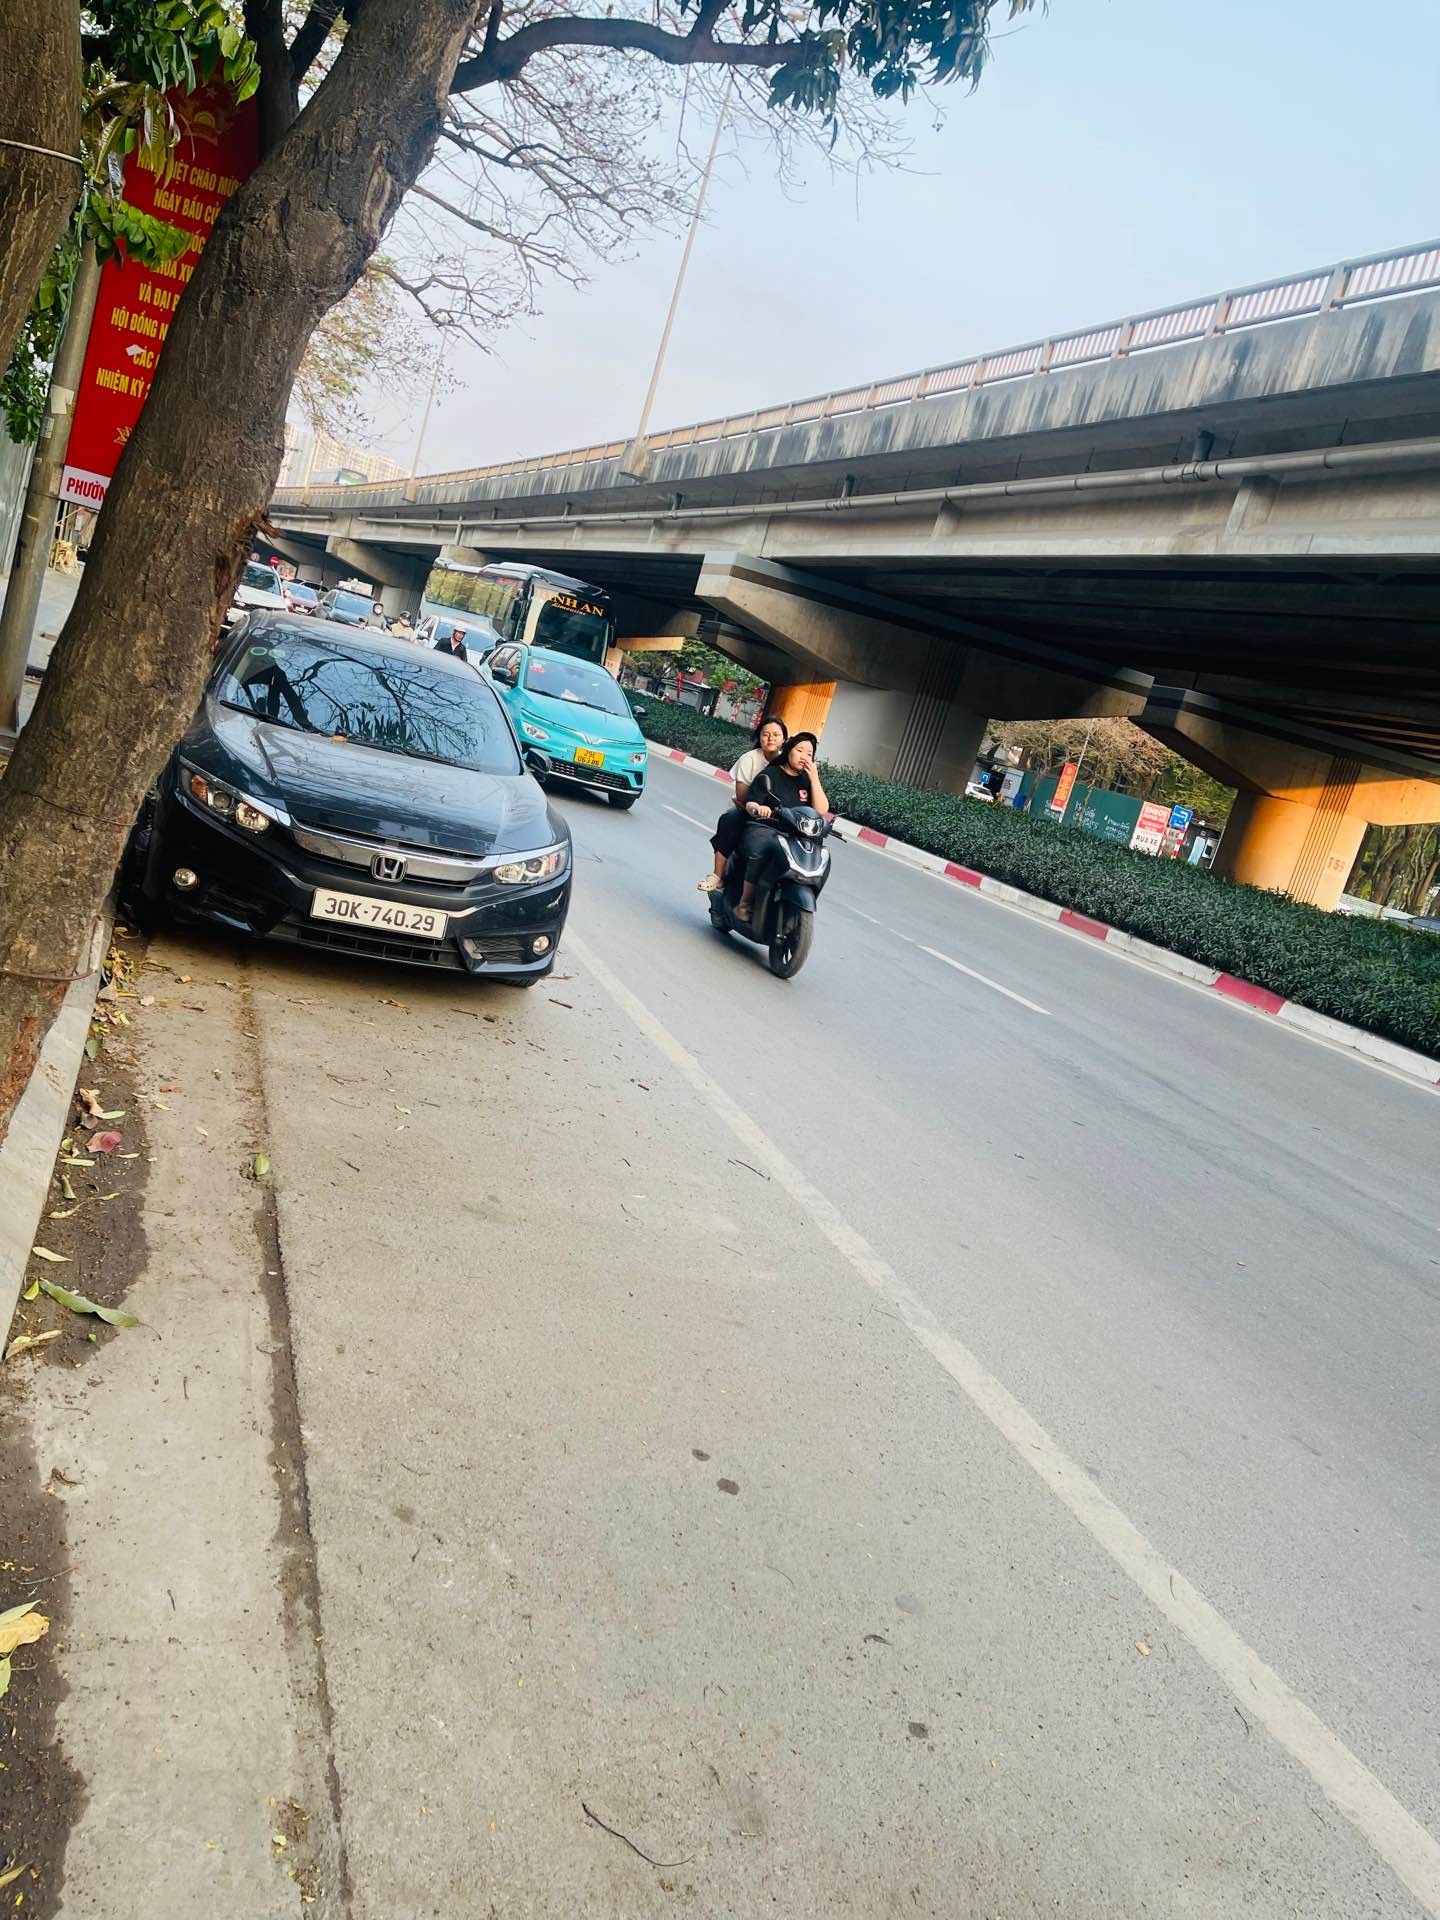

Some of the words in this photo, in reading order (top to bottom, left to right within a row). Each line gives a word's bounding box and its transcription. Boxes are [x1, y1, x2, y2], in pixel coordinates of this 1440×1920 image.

[153, 188, 182, 214] NGÀY
[178, 262, 195, 284] XV
[138, 280, 152, 304] VÀ
[152, 287, 172, 313] ĐẠI
[111, 305, 130, 332] HỘI
[96, 367, 130, 395] NHIỆM
[129, 376, 145, 398] KỲ
[66, 477, 107, 500] PHƯỜN
[580, 603, 604, 616] AN
[324, 897, 435, 932] 30K-740.29
